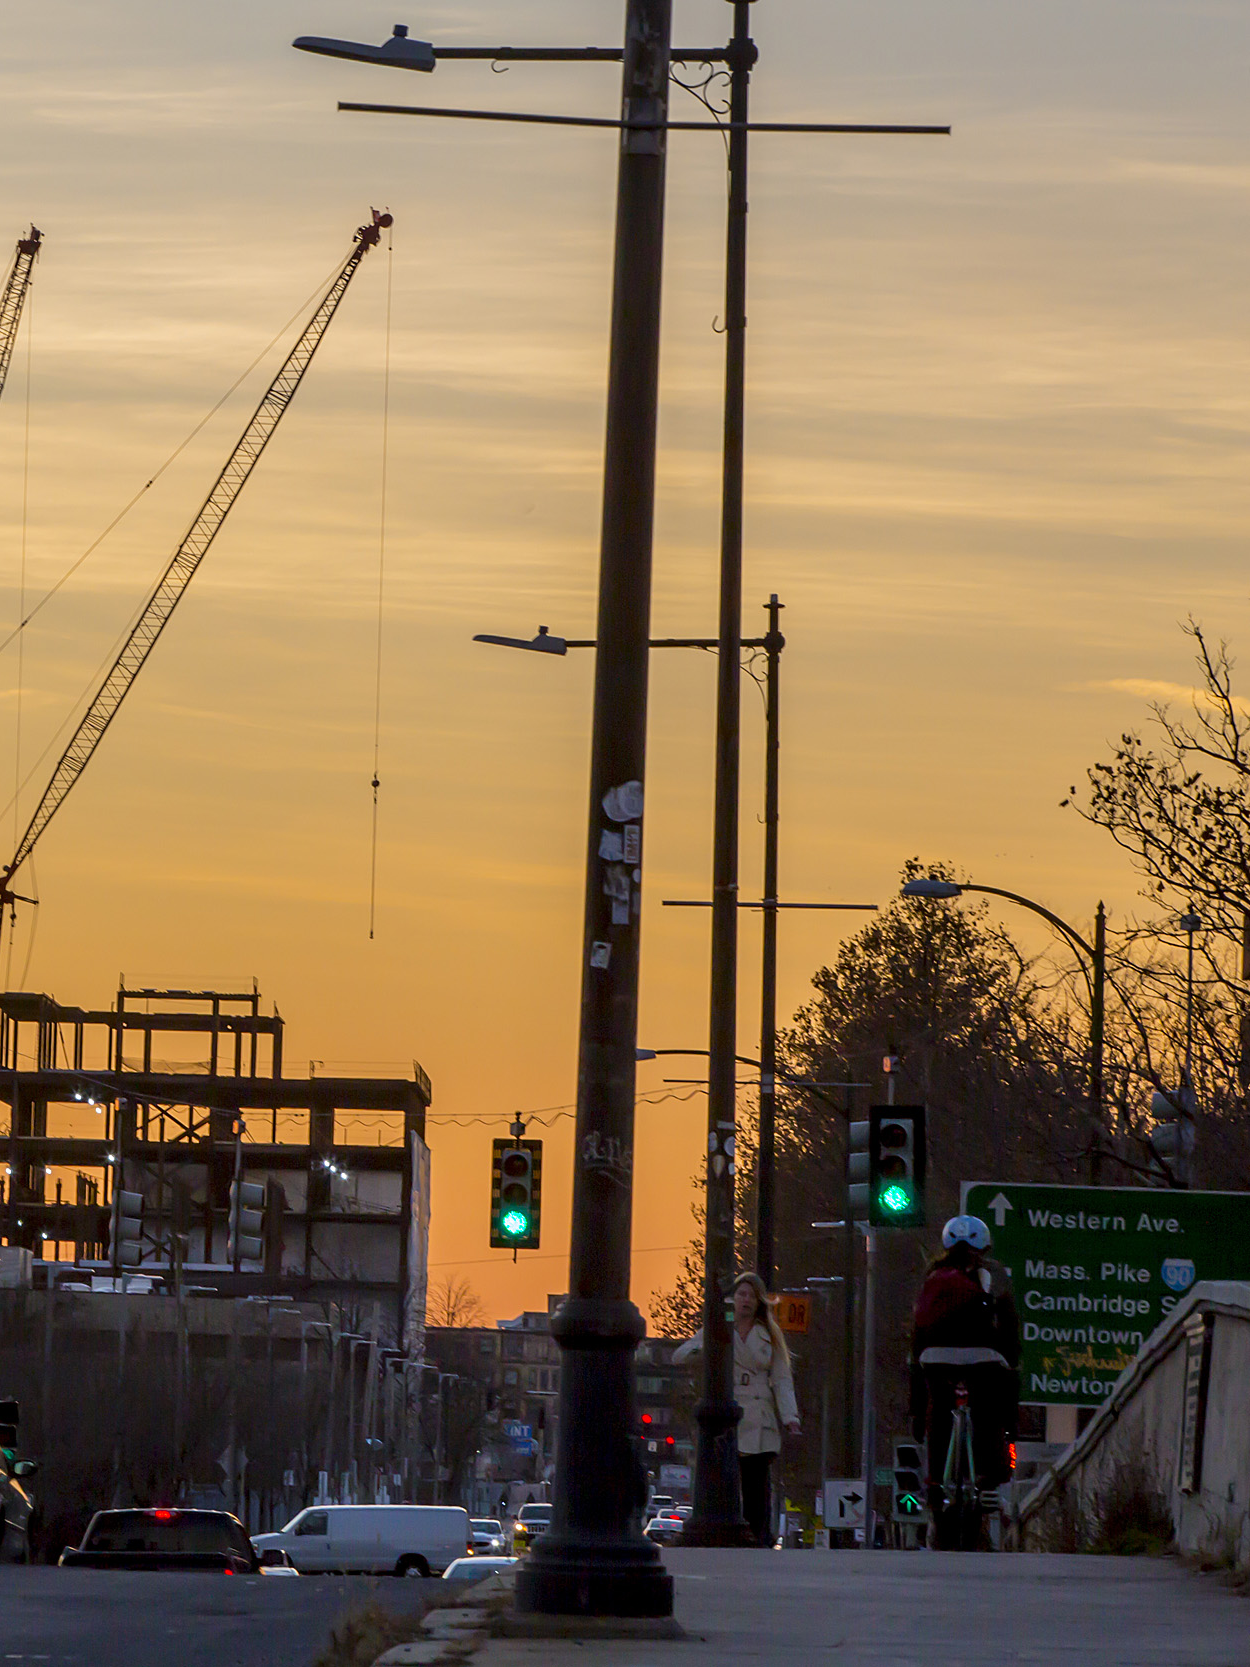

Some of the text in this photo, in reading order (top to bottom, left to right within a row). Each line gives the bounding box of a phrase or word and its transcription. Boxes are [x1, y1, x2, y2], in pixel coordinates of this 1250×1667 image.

[1028, 1209, 1185, 1233] Western Ave.
[1025, 1259, 1150, 1283] Mass. Pike
[1166, 1267, 1190, 1286] 90
[1024, 1290, 1150, 1317] Cambridge
[1023, 1322, 1143, 1345] Downtown
